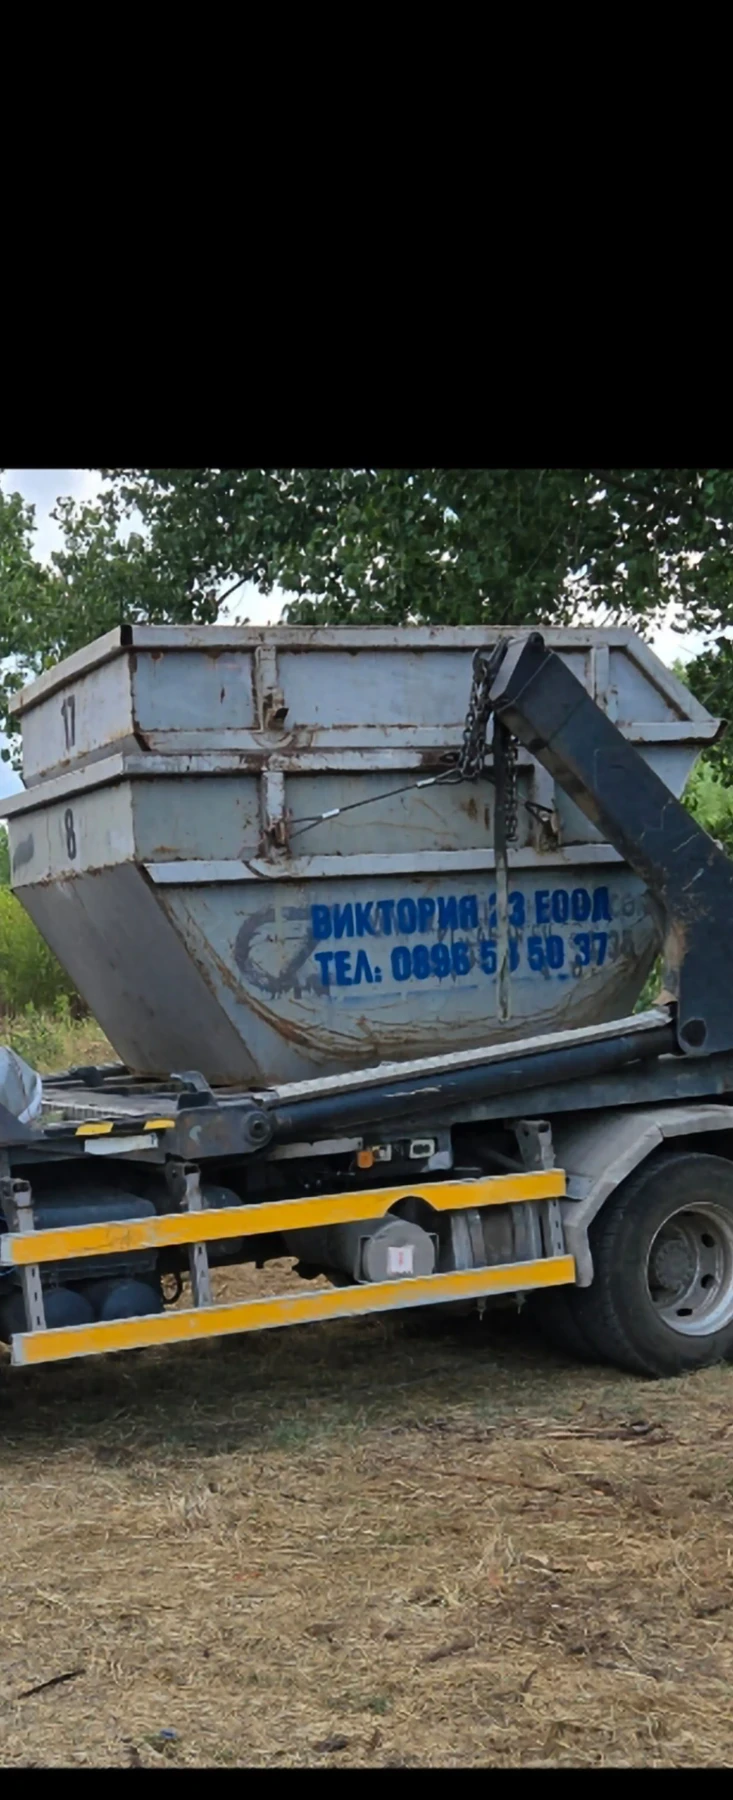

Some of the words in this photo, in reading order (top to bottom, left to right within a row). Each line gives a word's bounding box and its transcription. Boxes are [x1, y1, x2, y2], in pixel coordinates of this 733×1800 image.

[61, 694, 75, 750] 17
[64, 808, 76, 861] 8
[311, 894, 479, 940] ВИКТОРИЯ
[534, 886, 613, 924] ЕООД
[314, 948, 383, 986] ТЕЛ:
[527, 935, 564, 971] 50
[573, 931, 608, 967] 37
